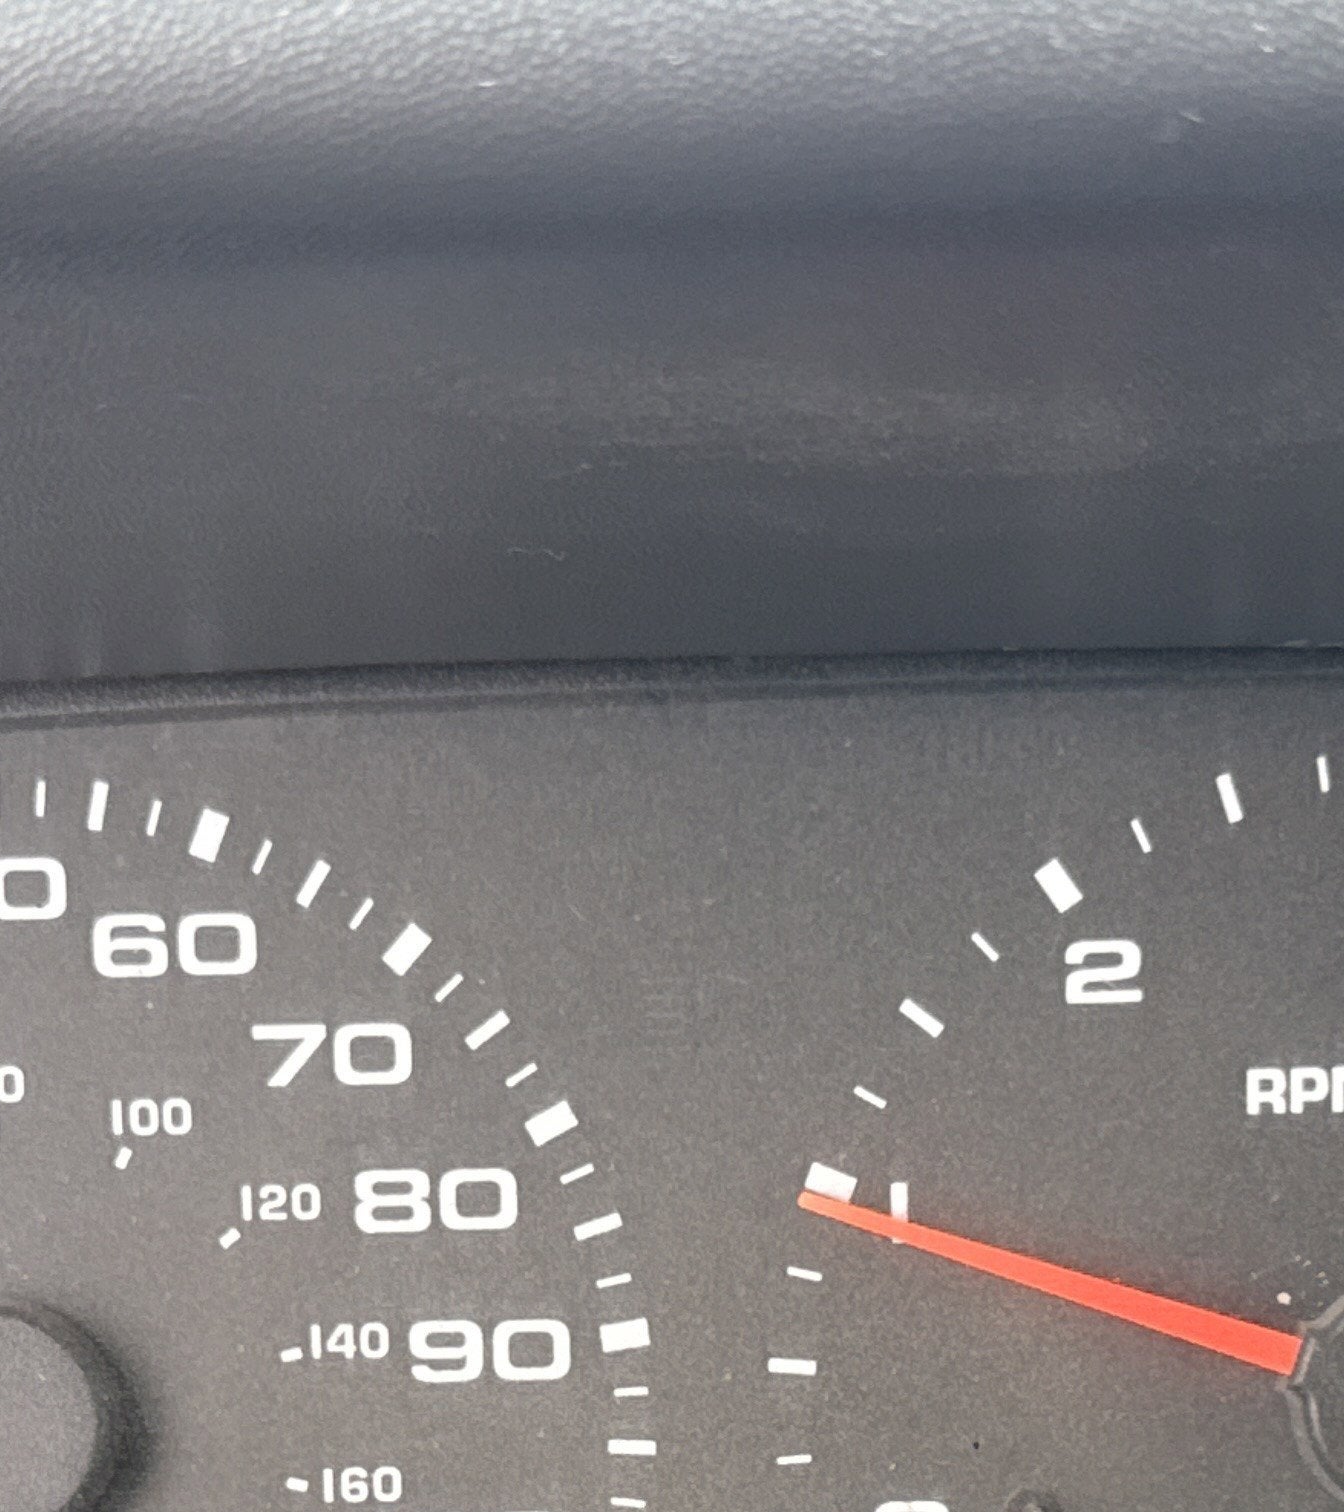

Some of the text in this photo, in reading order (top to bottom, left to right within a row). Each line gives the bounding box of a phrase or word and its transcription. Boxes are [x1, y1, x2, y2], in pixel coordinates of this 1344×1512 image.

[92, 912, 258, 978] 60
[1064, 939, 1143, 1005] 2
[251, 1022, 413, 1088] 70
[111, 1097, 193, 1137] 100
[240, 1182, 321, 1222] 120
[354, 1167, 518, 1234] 80
[309, 1321, 390, 1360] 140
[408, 1318, 572, 1384] 90
[322, 1465, 402, 1504] 160
